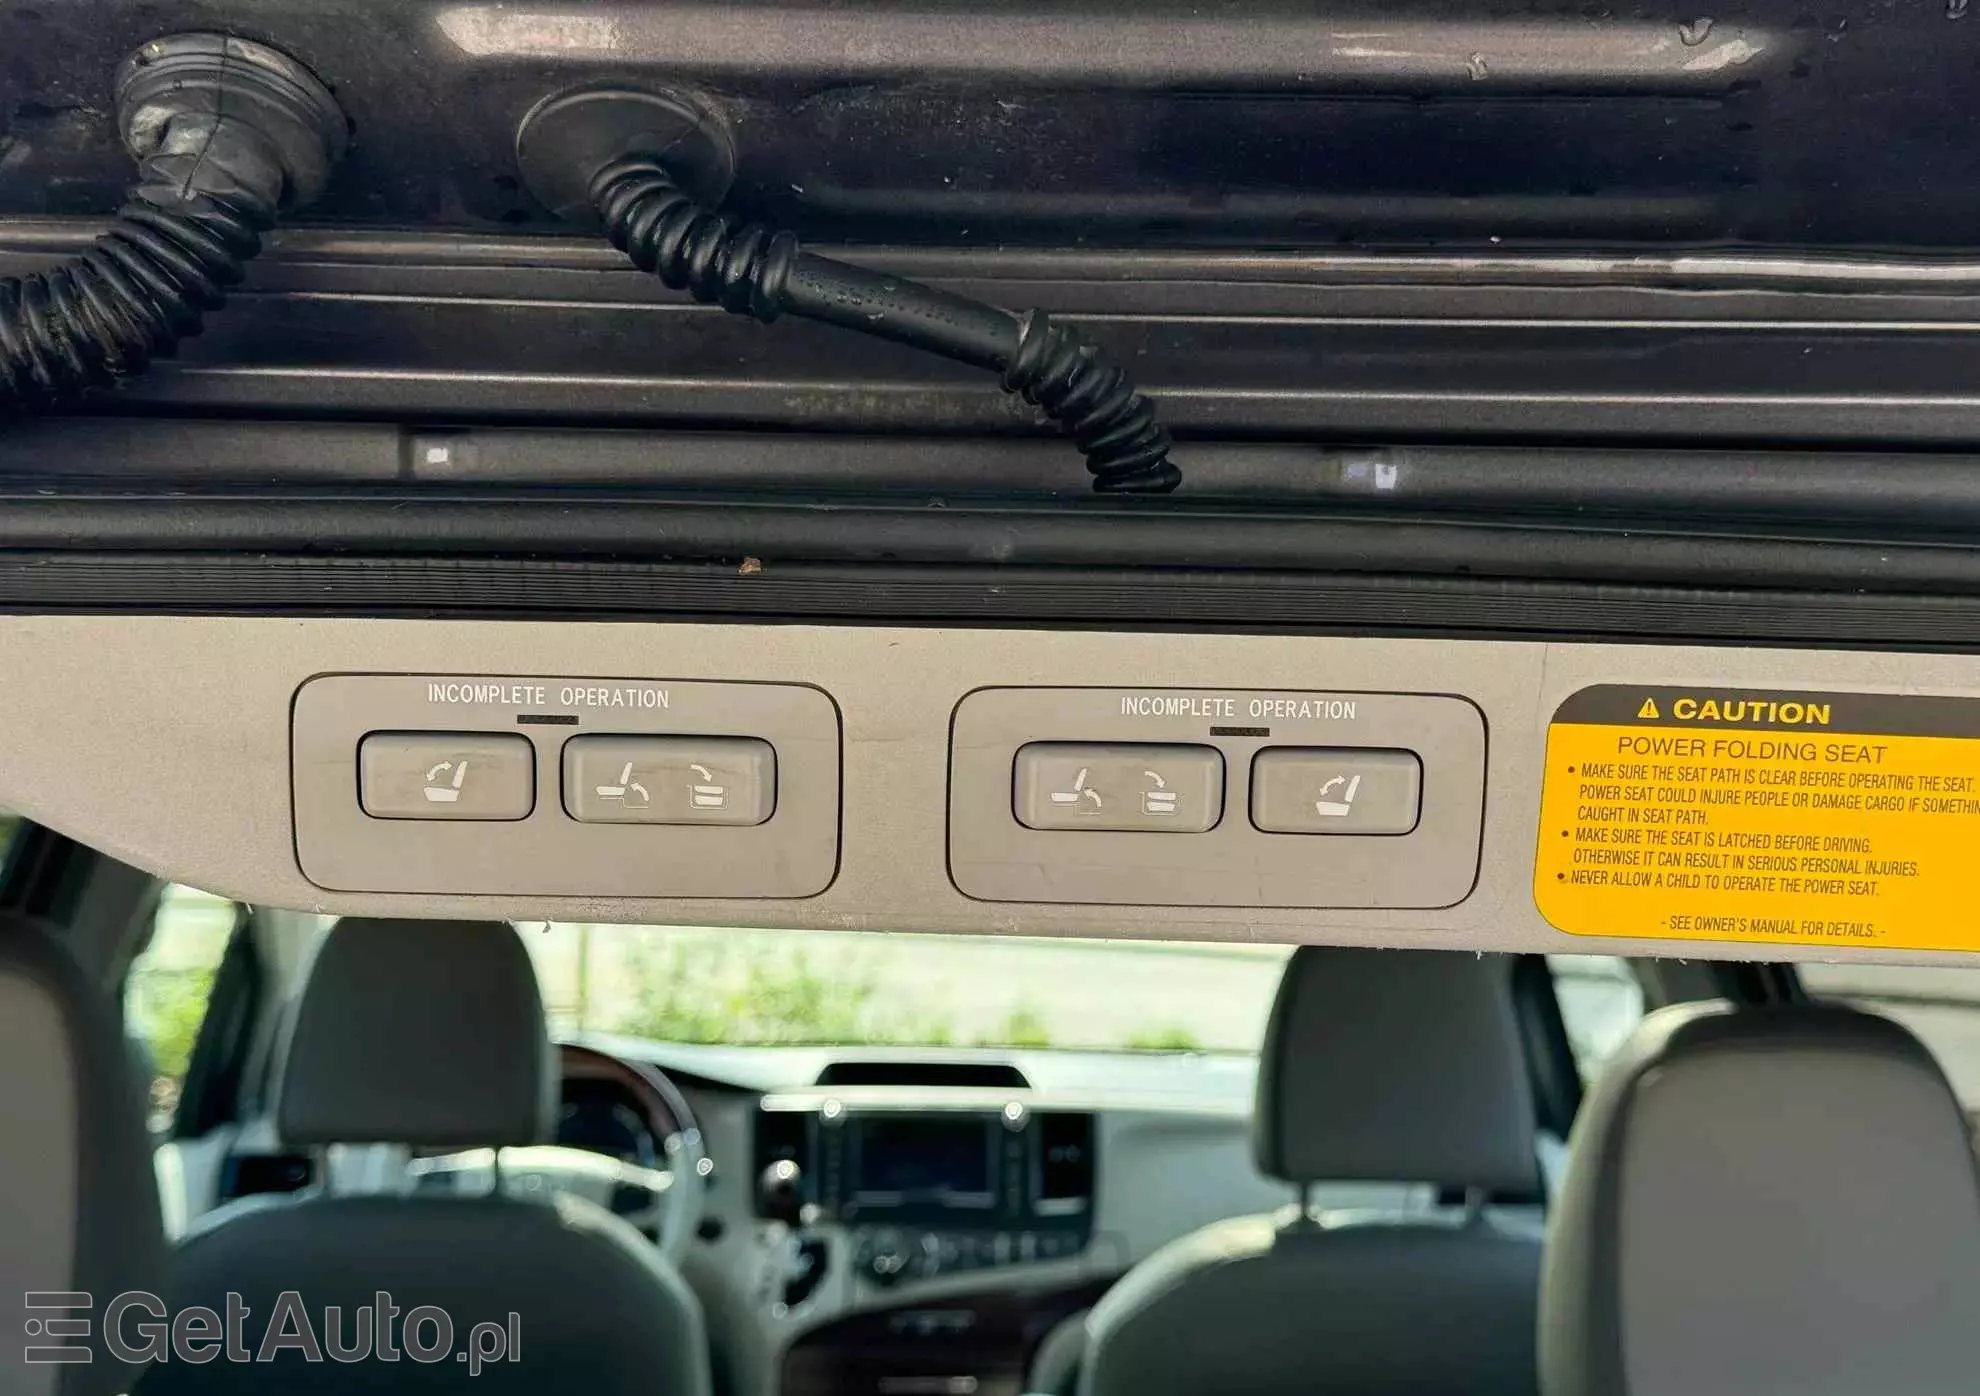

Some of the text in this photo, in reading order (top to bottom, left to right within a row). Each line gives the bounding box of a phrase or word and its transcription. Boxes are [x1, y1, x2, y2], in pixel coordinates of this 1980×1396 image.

[428, 684, 669, 708] INCOMPLETE OPERATION
[1121, 697, 1356, 719] INCOMPLETE OPERATION
[1673, 698, 1830, 724] CAUTION
[1618, 736, 1888, 764] POWER FOLDING SEAT
[1581, 763, 1976, 793] MAKE SURE THE SEAT PATH IS CLEAR BEFORE OPERATING THE SEAT.
[1579, 784, 1620, 800] POWER
[1624, 786, 1654, 801] SEAT
[1657, 788, 1696, 803] COULD
[1700, 789, 1741, 805] INJURE
[1745, 791, 1788, 806] PEOPLE
[1792, 792, 1808, 807] OR
[1812, 793, 1861, 809] DAMAGE
[1865, 795, 1904, 811] CARGO
[1908, 798, 1920, 813] IF
[1578, 805, 1708, 825] CAUGHT IN SEAT PATH.
[1576, 828, 1872, 854] MAKE SURE THE SEAT IS LATCHED BEFORE DRIVING.
[1574, 848, 1920, 877] OTHERWISE IT CAN RESULT IN SERIOUS PERSONAL INJURIES.
[1571, 870, 1879, 896] NEVER ALLOW A CHILD TO OPERATE THE POWER SEAT.
[1670, 916, 1691, 930] SEE
[1694, 917, 1747, 932] OWNER'S
[1750, 920, 1797, 934] MANUAL
[1801, 921, 1823, 935] FOR
[1827, 922, 1877, 938] DETAILS.
